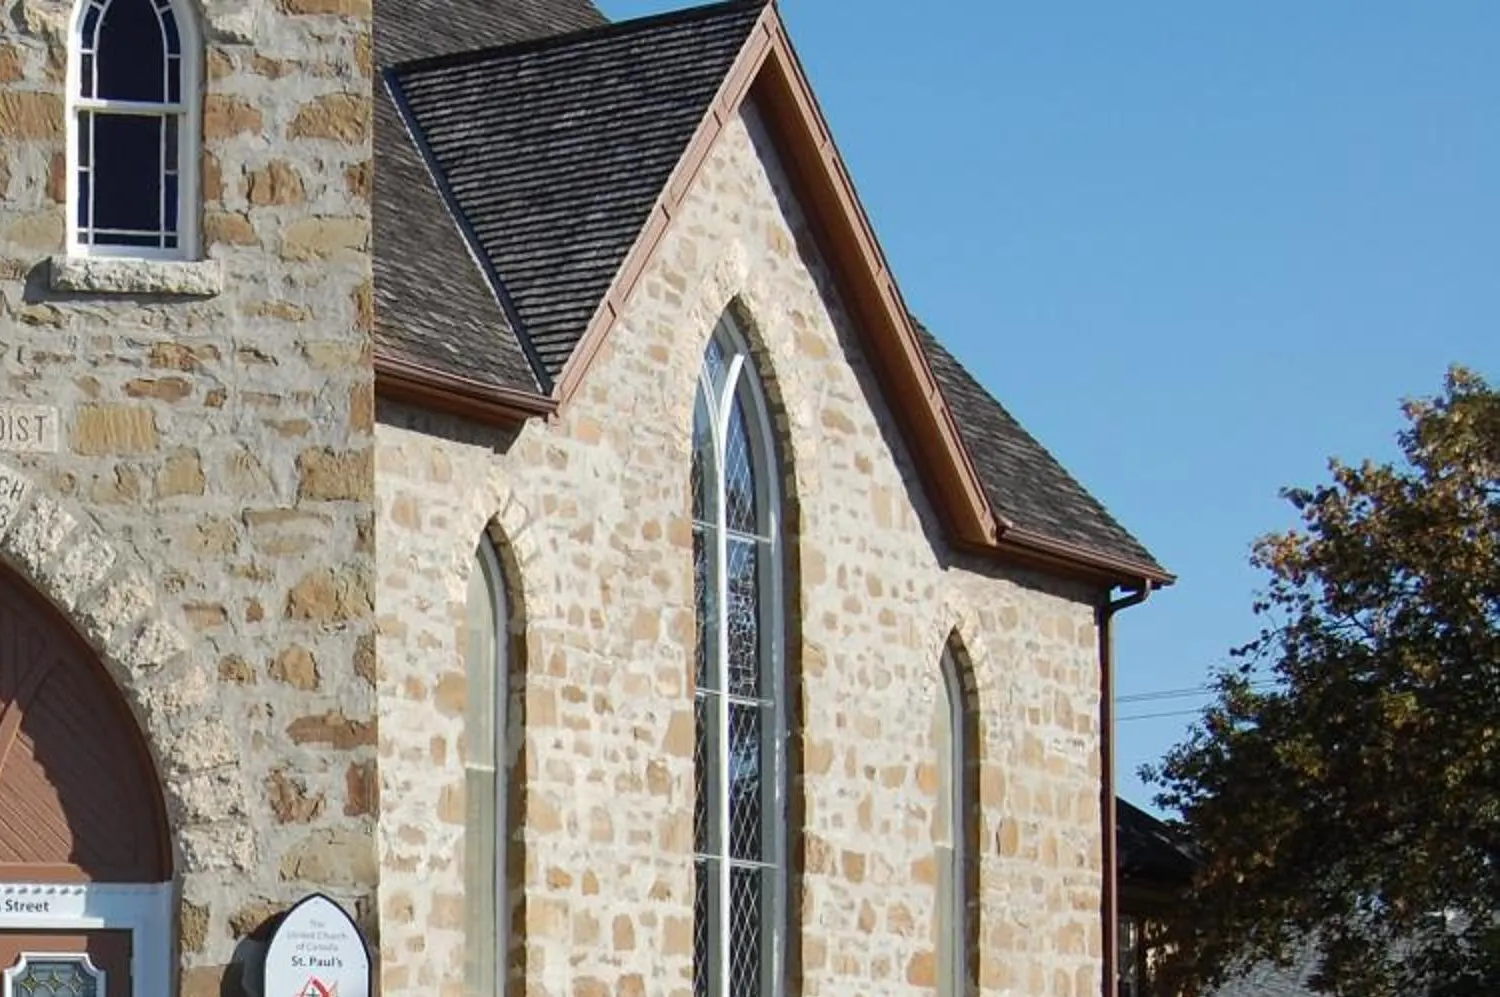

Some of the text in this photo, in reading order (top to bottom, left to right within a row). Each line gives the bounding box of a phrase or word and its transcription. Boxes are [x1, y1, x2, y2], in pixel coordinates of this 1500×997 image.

[4, 898, 50, 913] Street
[291, 955, 344, 969] St. Paul's
